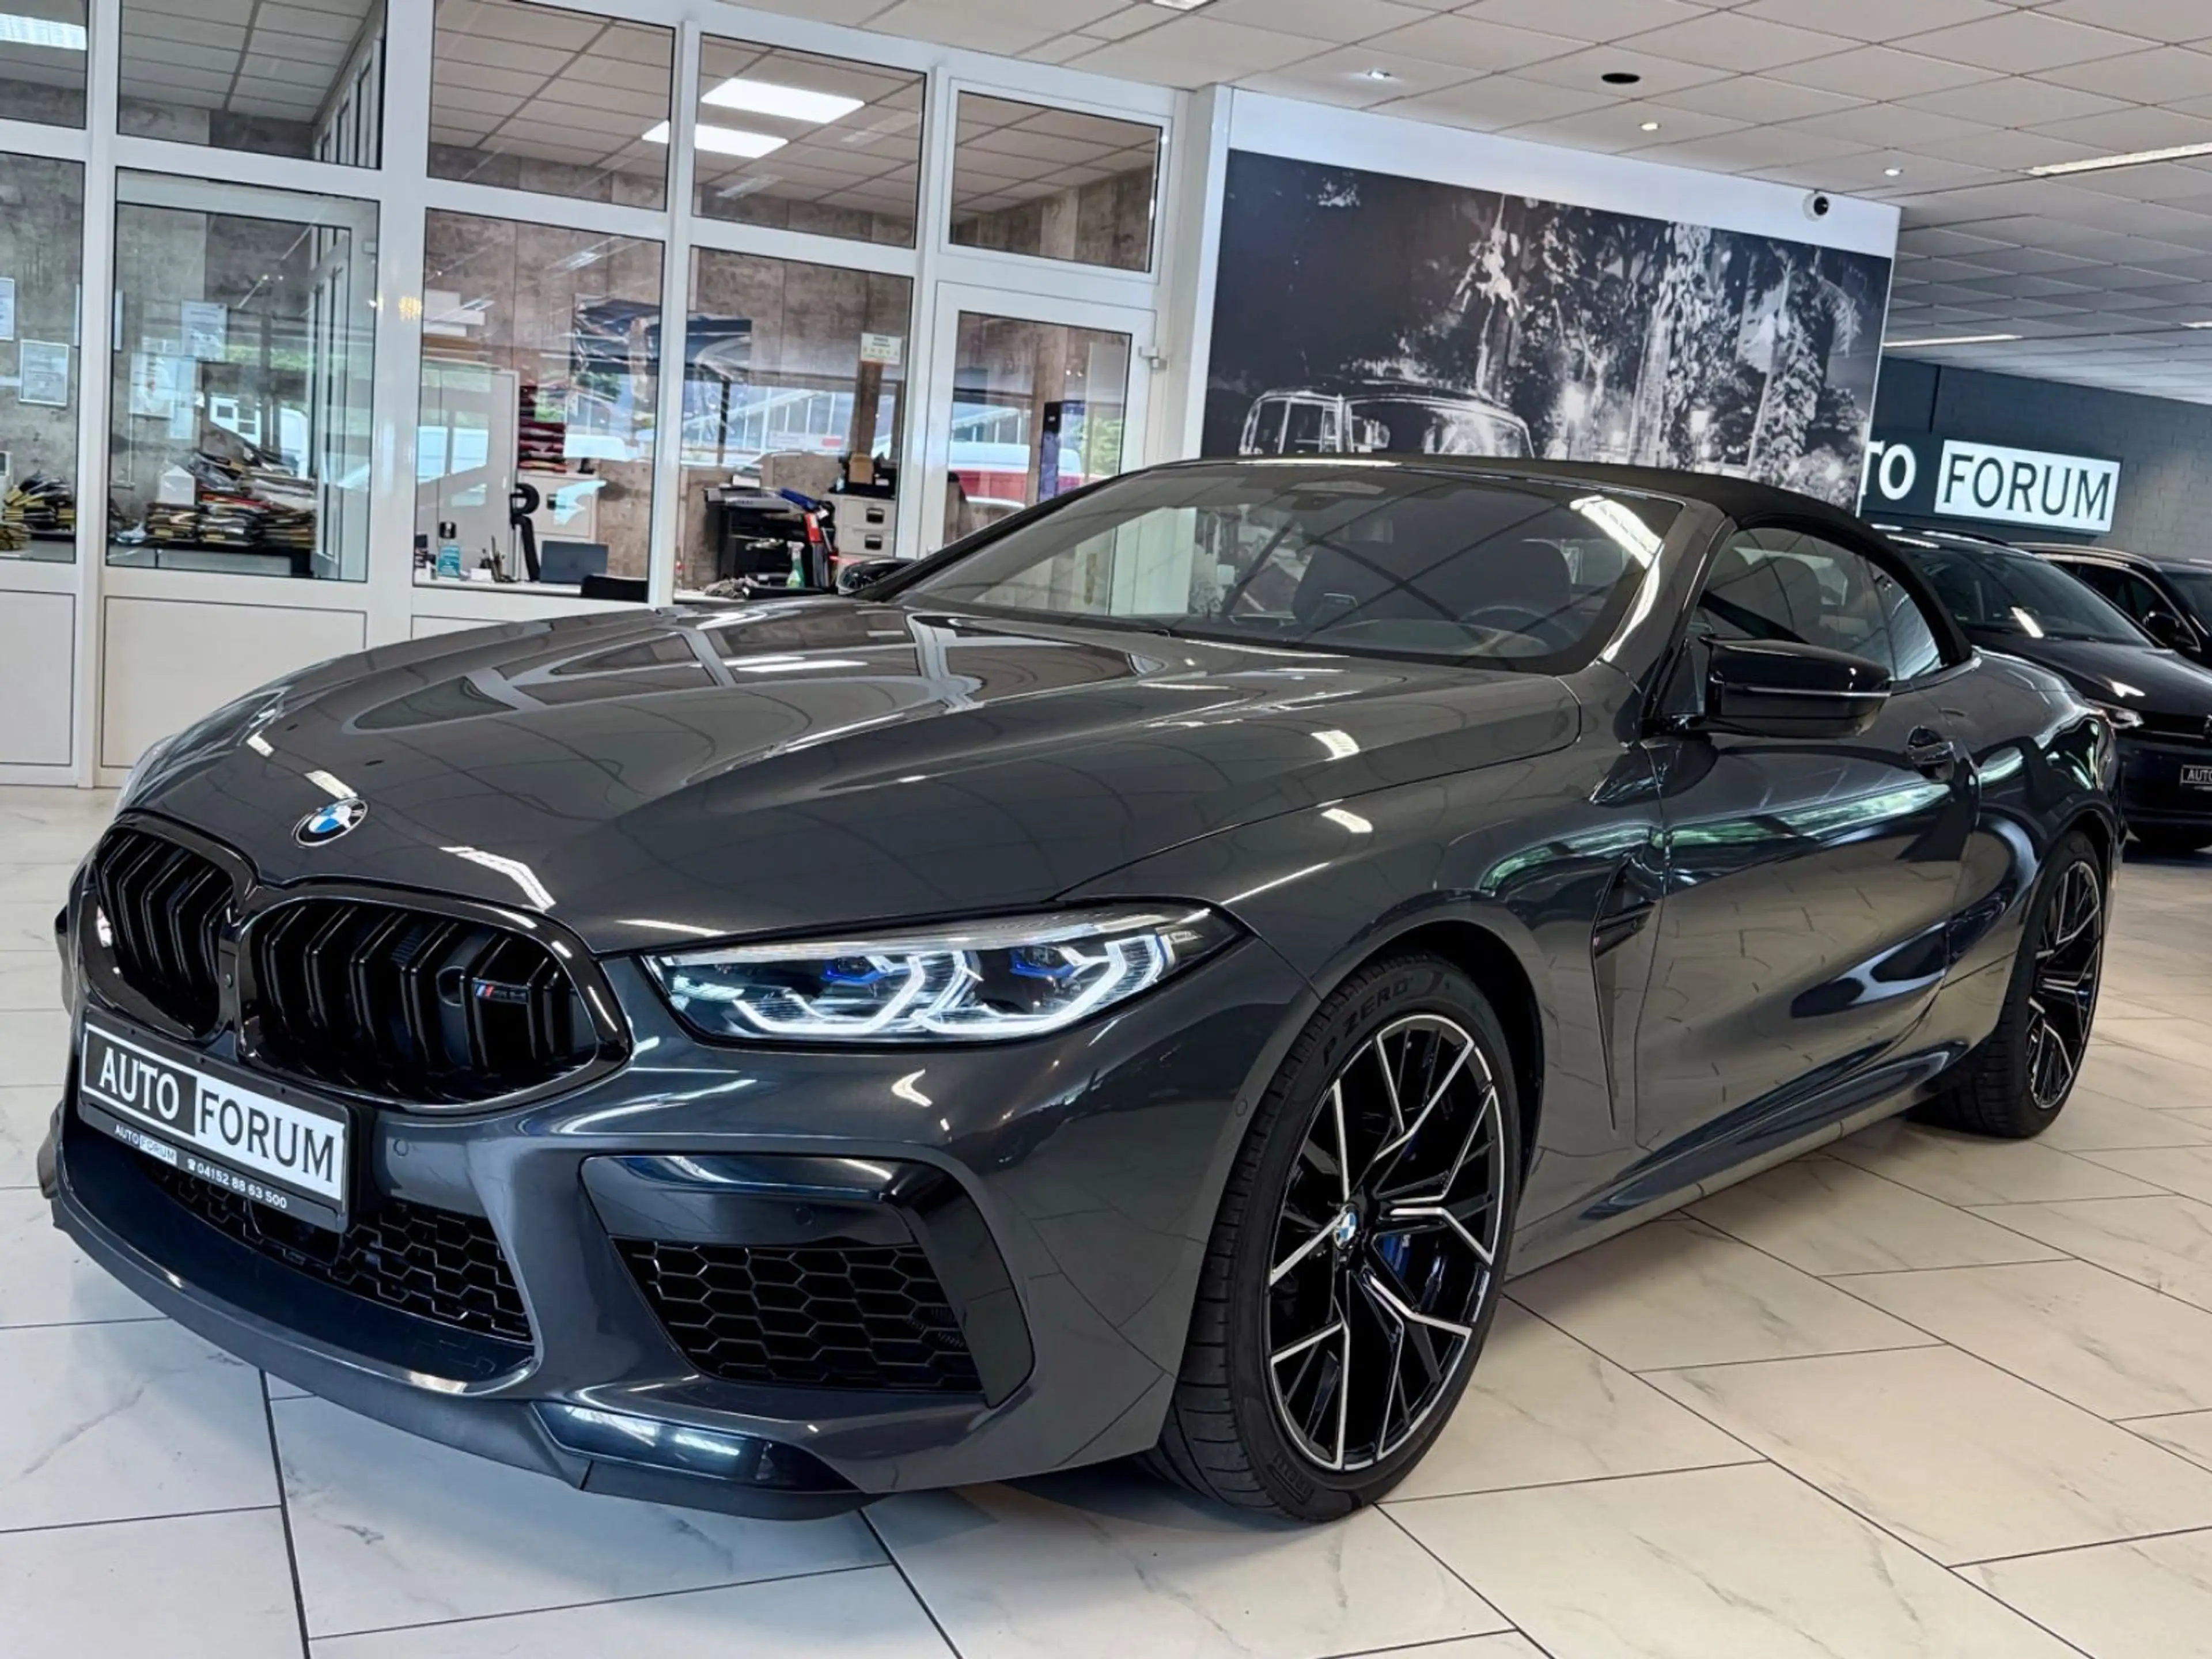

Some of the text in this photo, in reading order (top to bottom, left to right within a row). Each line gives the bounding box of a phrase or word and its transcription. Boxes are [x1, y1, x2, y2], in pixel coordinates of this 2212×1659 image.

[1943, 453, 2111, 521] FORUM
[1343, 978, 1410, 1039] ZERO
[99, 1046, 335, 1183] AUTO FORUM
[196, 1162, 230, 1186] 04152
[264, 1190, 287, 1209] 500
